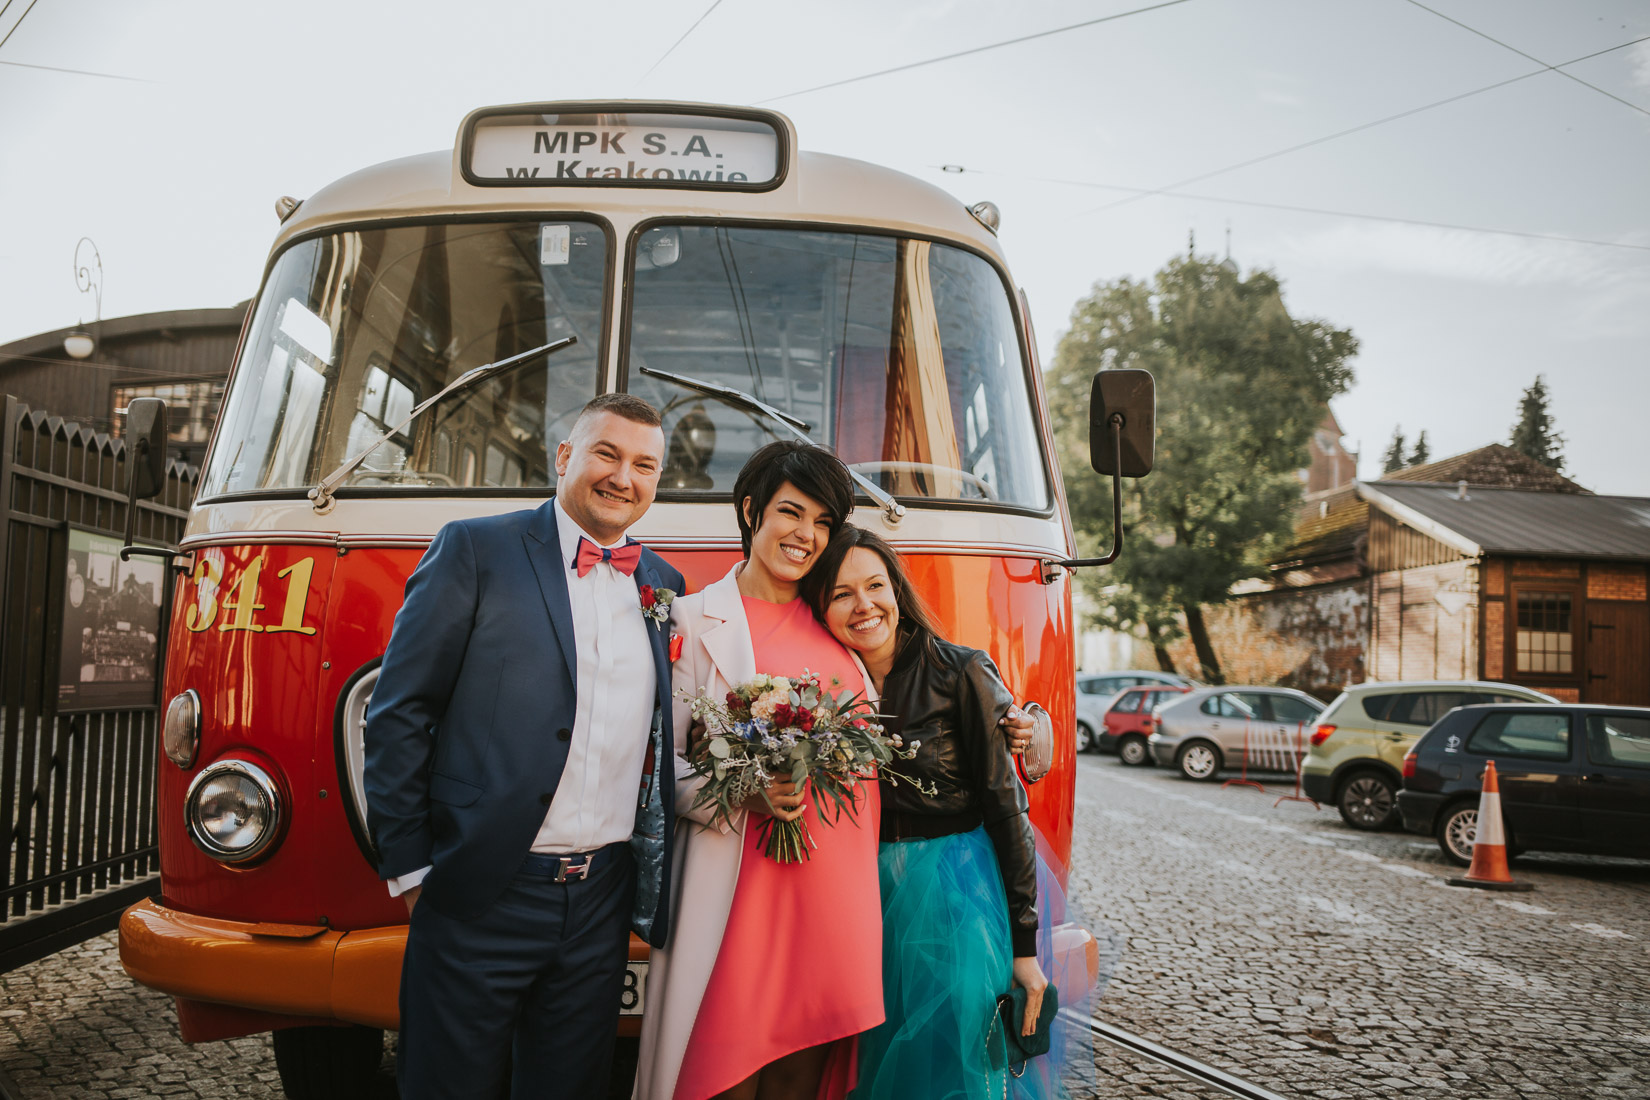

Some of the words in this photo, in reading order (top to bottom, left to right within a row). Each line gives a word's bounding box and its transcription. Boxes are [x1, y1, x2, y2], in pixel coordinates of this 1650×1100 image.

[533, 131, 627, 154] MPK
[642, 132, 724, 158] S.A.
[505, 167, 540, 178] w
[556, 160, 748, 182] Krakowie
[186, 555, 317, 636] 341
